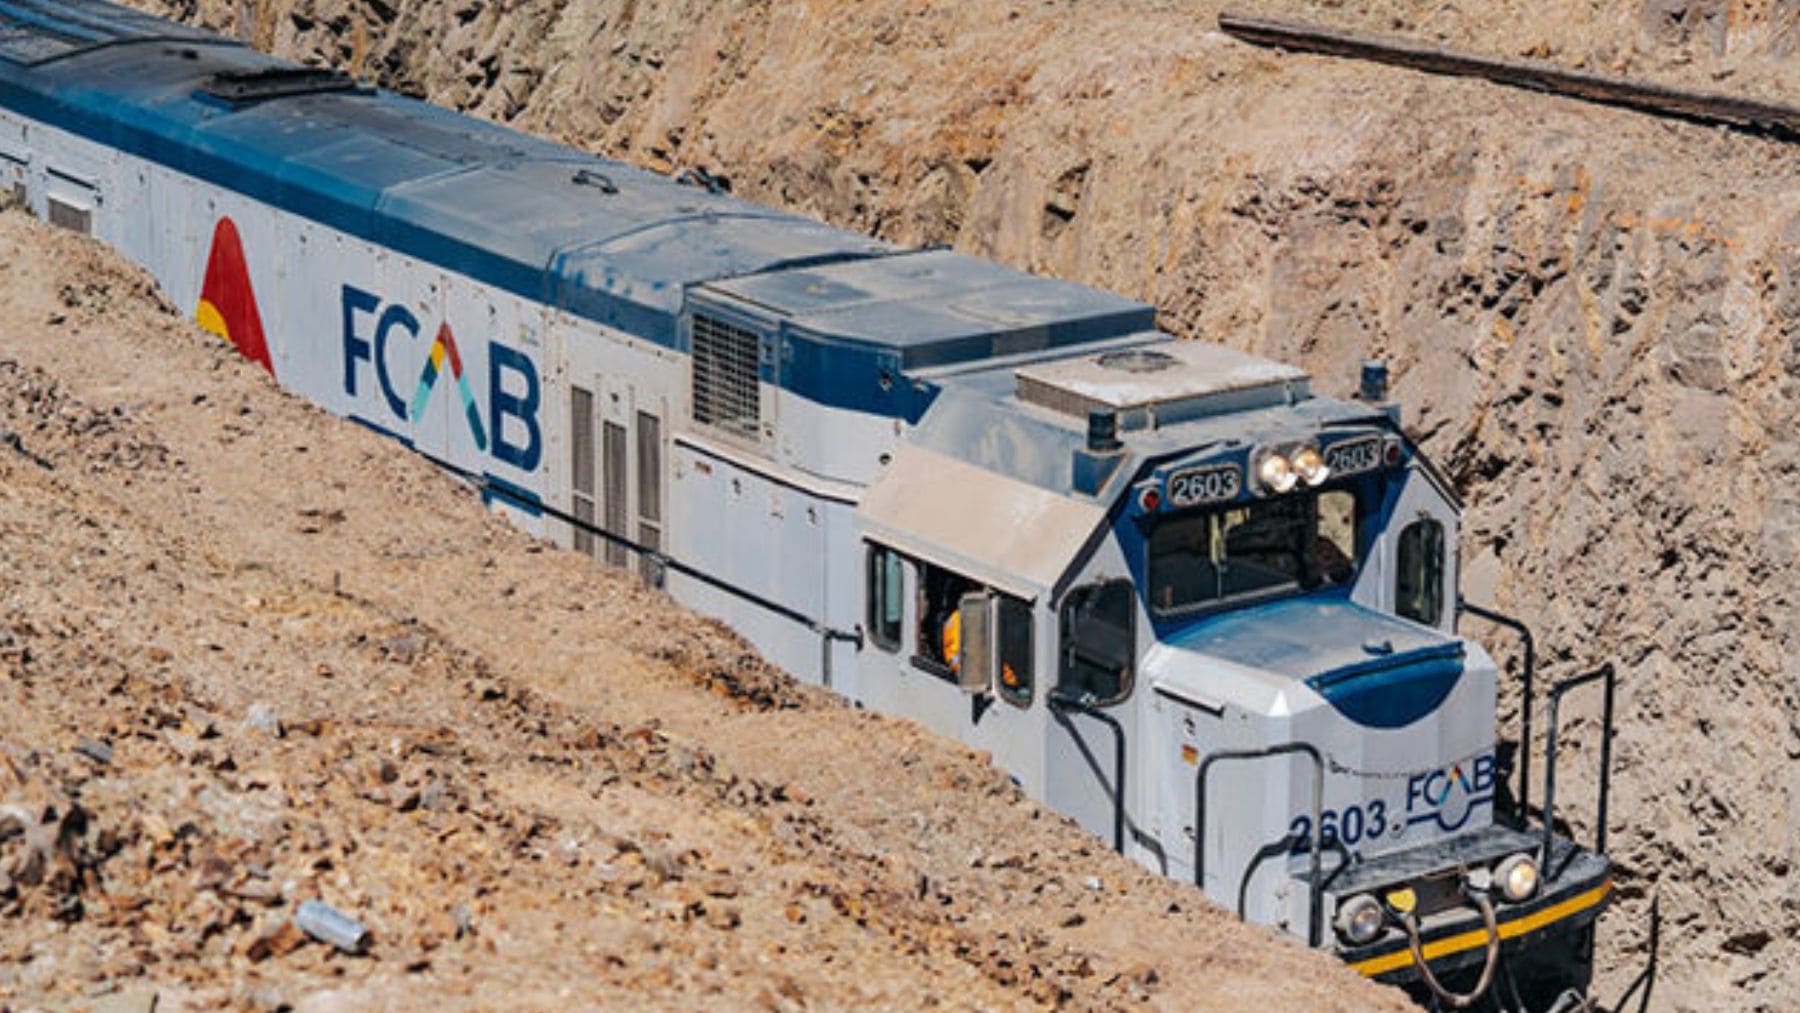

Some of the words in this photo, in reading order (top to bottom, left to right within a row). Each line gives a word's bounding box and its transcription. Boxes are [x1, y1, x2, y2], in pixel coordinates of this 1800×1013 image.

[342, 283, 541, 472] FCAB
[1174, 472, 1238, 500] 2603
[1330, 446, 1376, 469] 2603
[1407, 755, 1495, 812] FCAB
[1290, 799, 1387, 856] 2603
